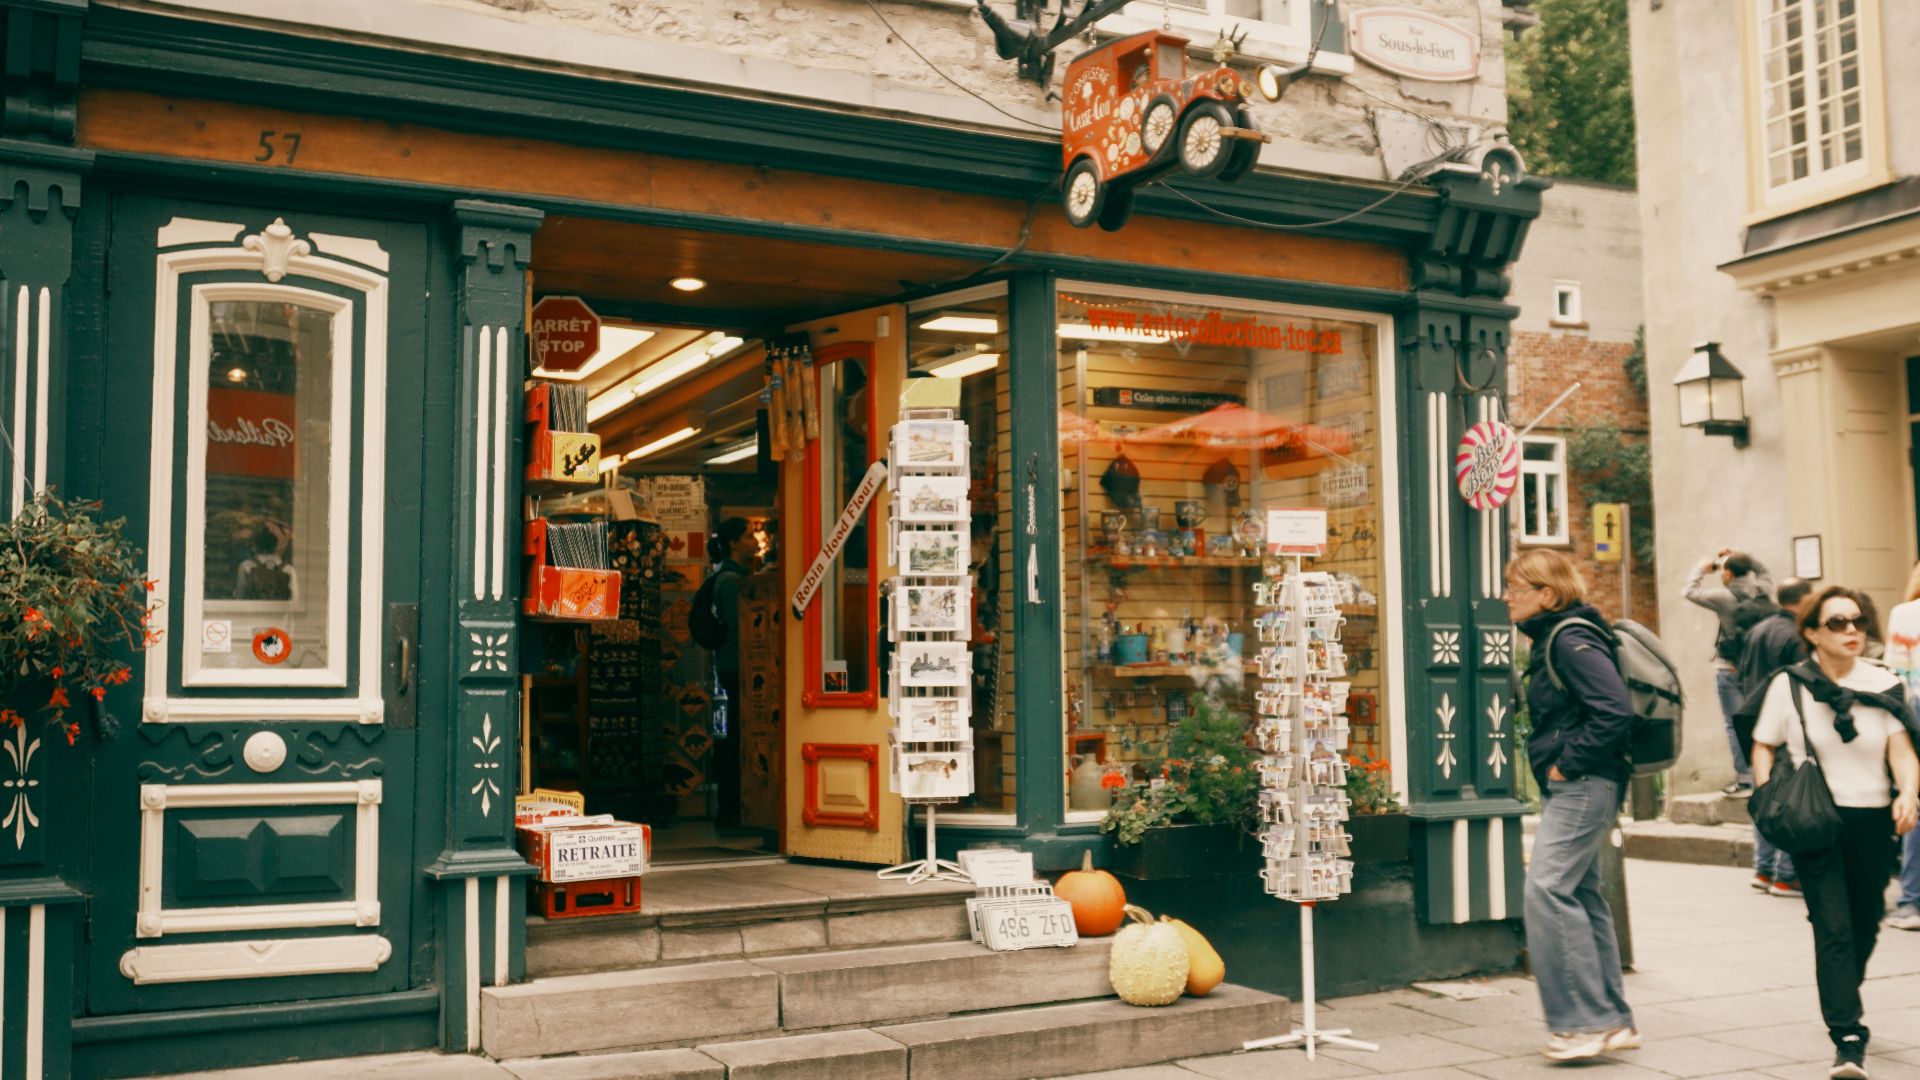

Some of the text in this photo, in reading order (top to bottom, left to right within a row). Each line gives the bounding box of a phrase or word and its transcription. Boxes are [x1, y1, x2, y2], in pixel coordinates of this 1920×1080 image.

[1379, 32, 1456, 60] Sous-le-Fort
[255, 130, 301, 164] 57
[534, 316, 592, 333] ARRÊT
[1087, 308, 1342, 355] www.autocollection-tcc.ca
[540, 340, 585, 353] STOP
[1134, 392, 1154, 403] Coke
[1475, 434, 1501, 465] Bon
[795, 476, 875, 605] Robin Hood Flour
[538, 795, 580, 809] WARNING
[588, 834, 616, 843] Québec
[557, 842, 637, 863] RETRAITÉ
[999, 917, 1031, 939] 496
